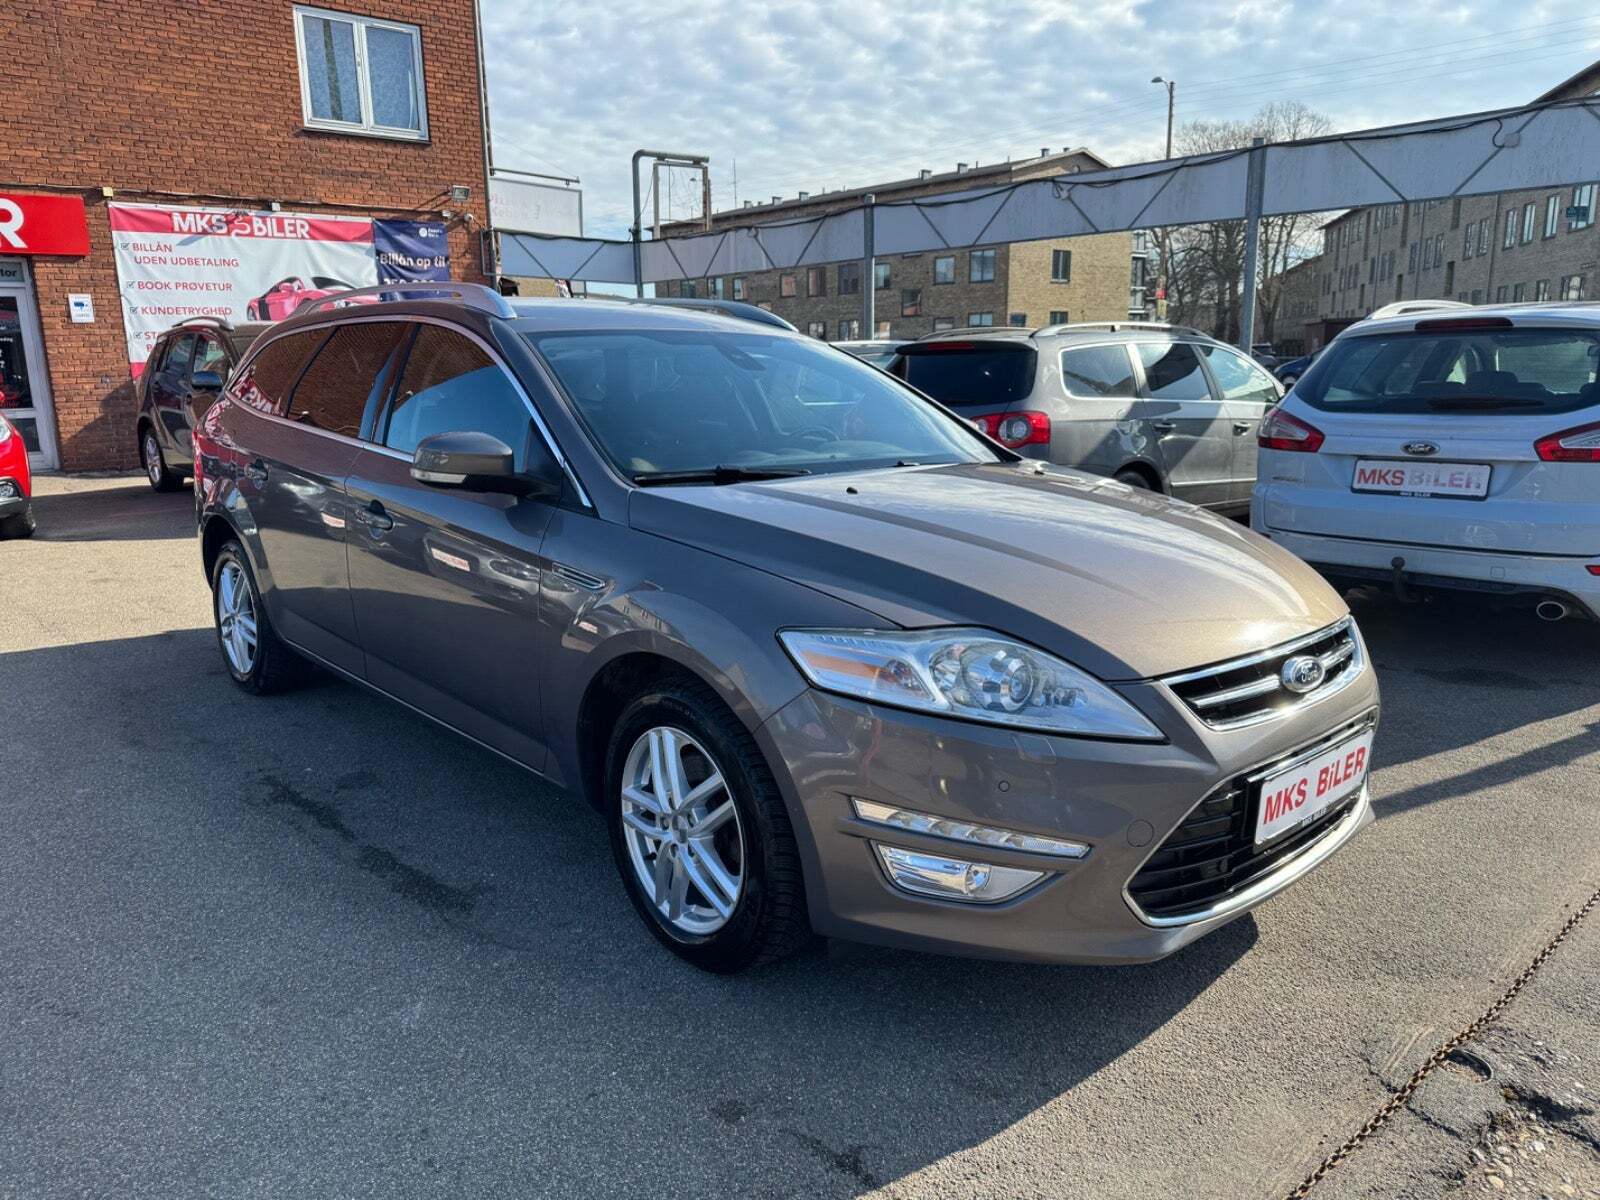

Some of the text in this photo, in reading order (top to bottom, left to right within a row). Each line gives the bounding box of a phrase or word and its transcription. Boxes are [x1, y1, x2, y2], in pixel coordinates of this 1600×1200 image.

[172, 212, 228, 234] MKS
[132, 241, 173, 253] BILLÅN
[134, 256, 240, 267] UDEN UDBETALING
[416, 258, 431, 270] op
[434, 255, 446, 268] til
[137, 281, 233, 292] BOOK PRØVETUR
[141, 306, 233, 316] KUNDETRYGHED
[1357, 468, 1405, 486] MKS
[1263, 777, 1308, 825] MKS
